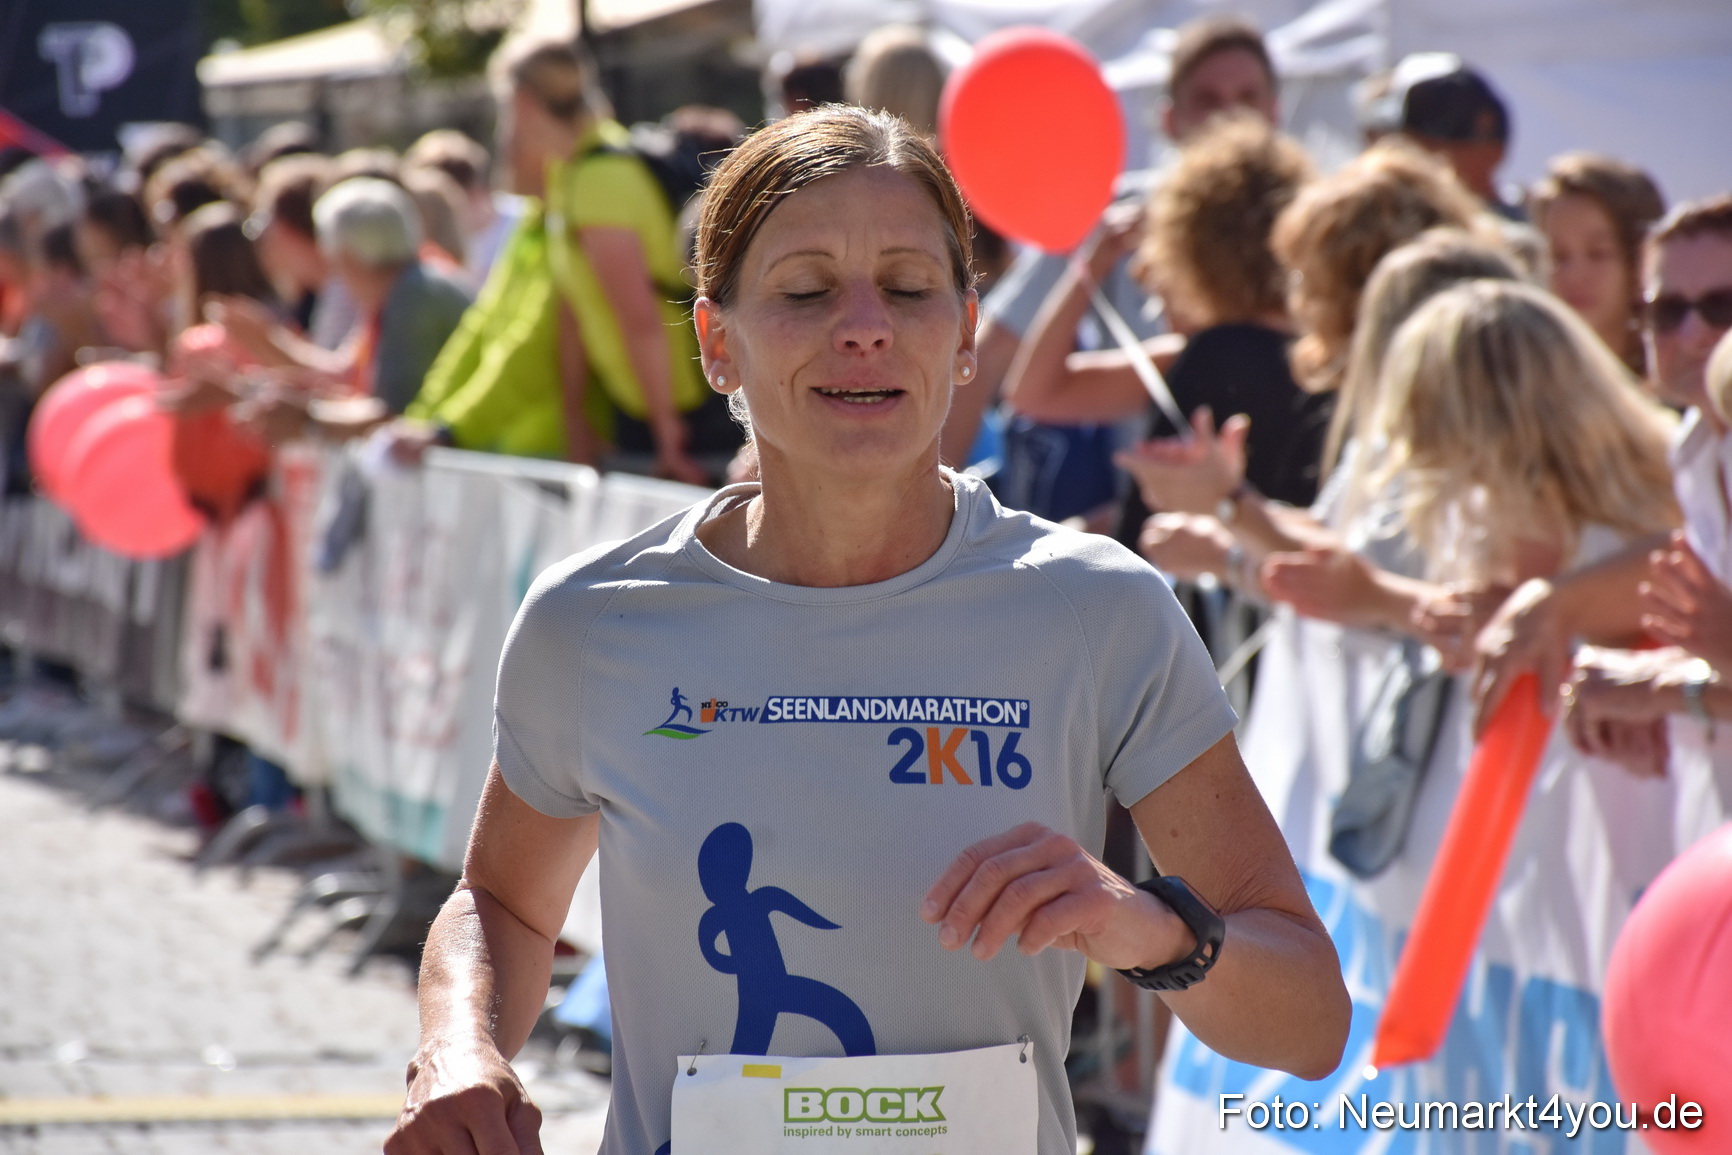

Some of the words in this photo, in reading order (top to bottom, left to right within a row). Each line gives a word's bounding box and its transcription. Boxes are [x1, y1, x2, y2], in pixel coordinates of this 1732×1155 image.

[713, 707, 760, 722] KTW
[887, 727, 1032, 790] 2K16
[784, 1086, 946, 1123] BOCK
[783, 1126, 833, 1139] inspired
[837, 1126, 852, 1139] by
[855, 1126, 892, 1138] smart
[895, 1125, 948, 1138] concepts
